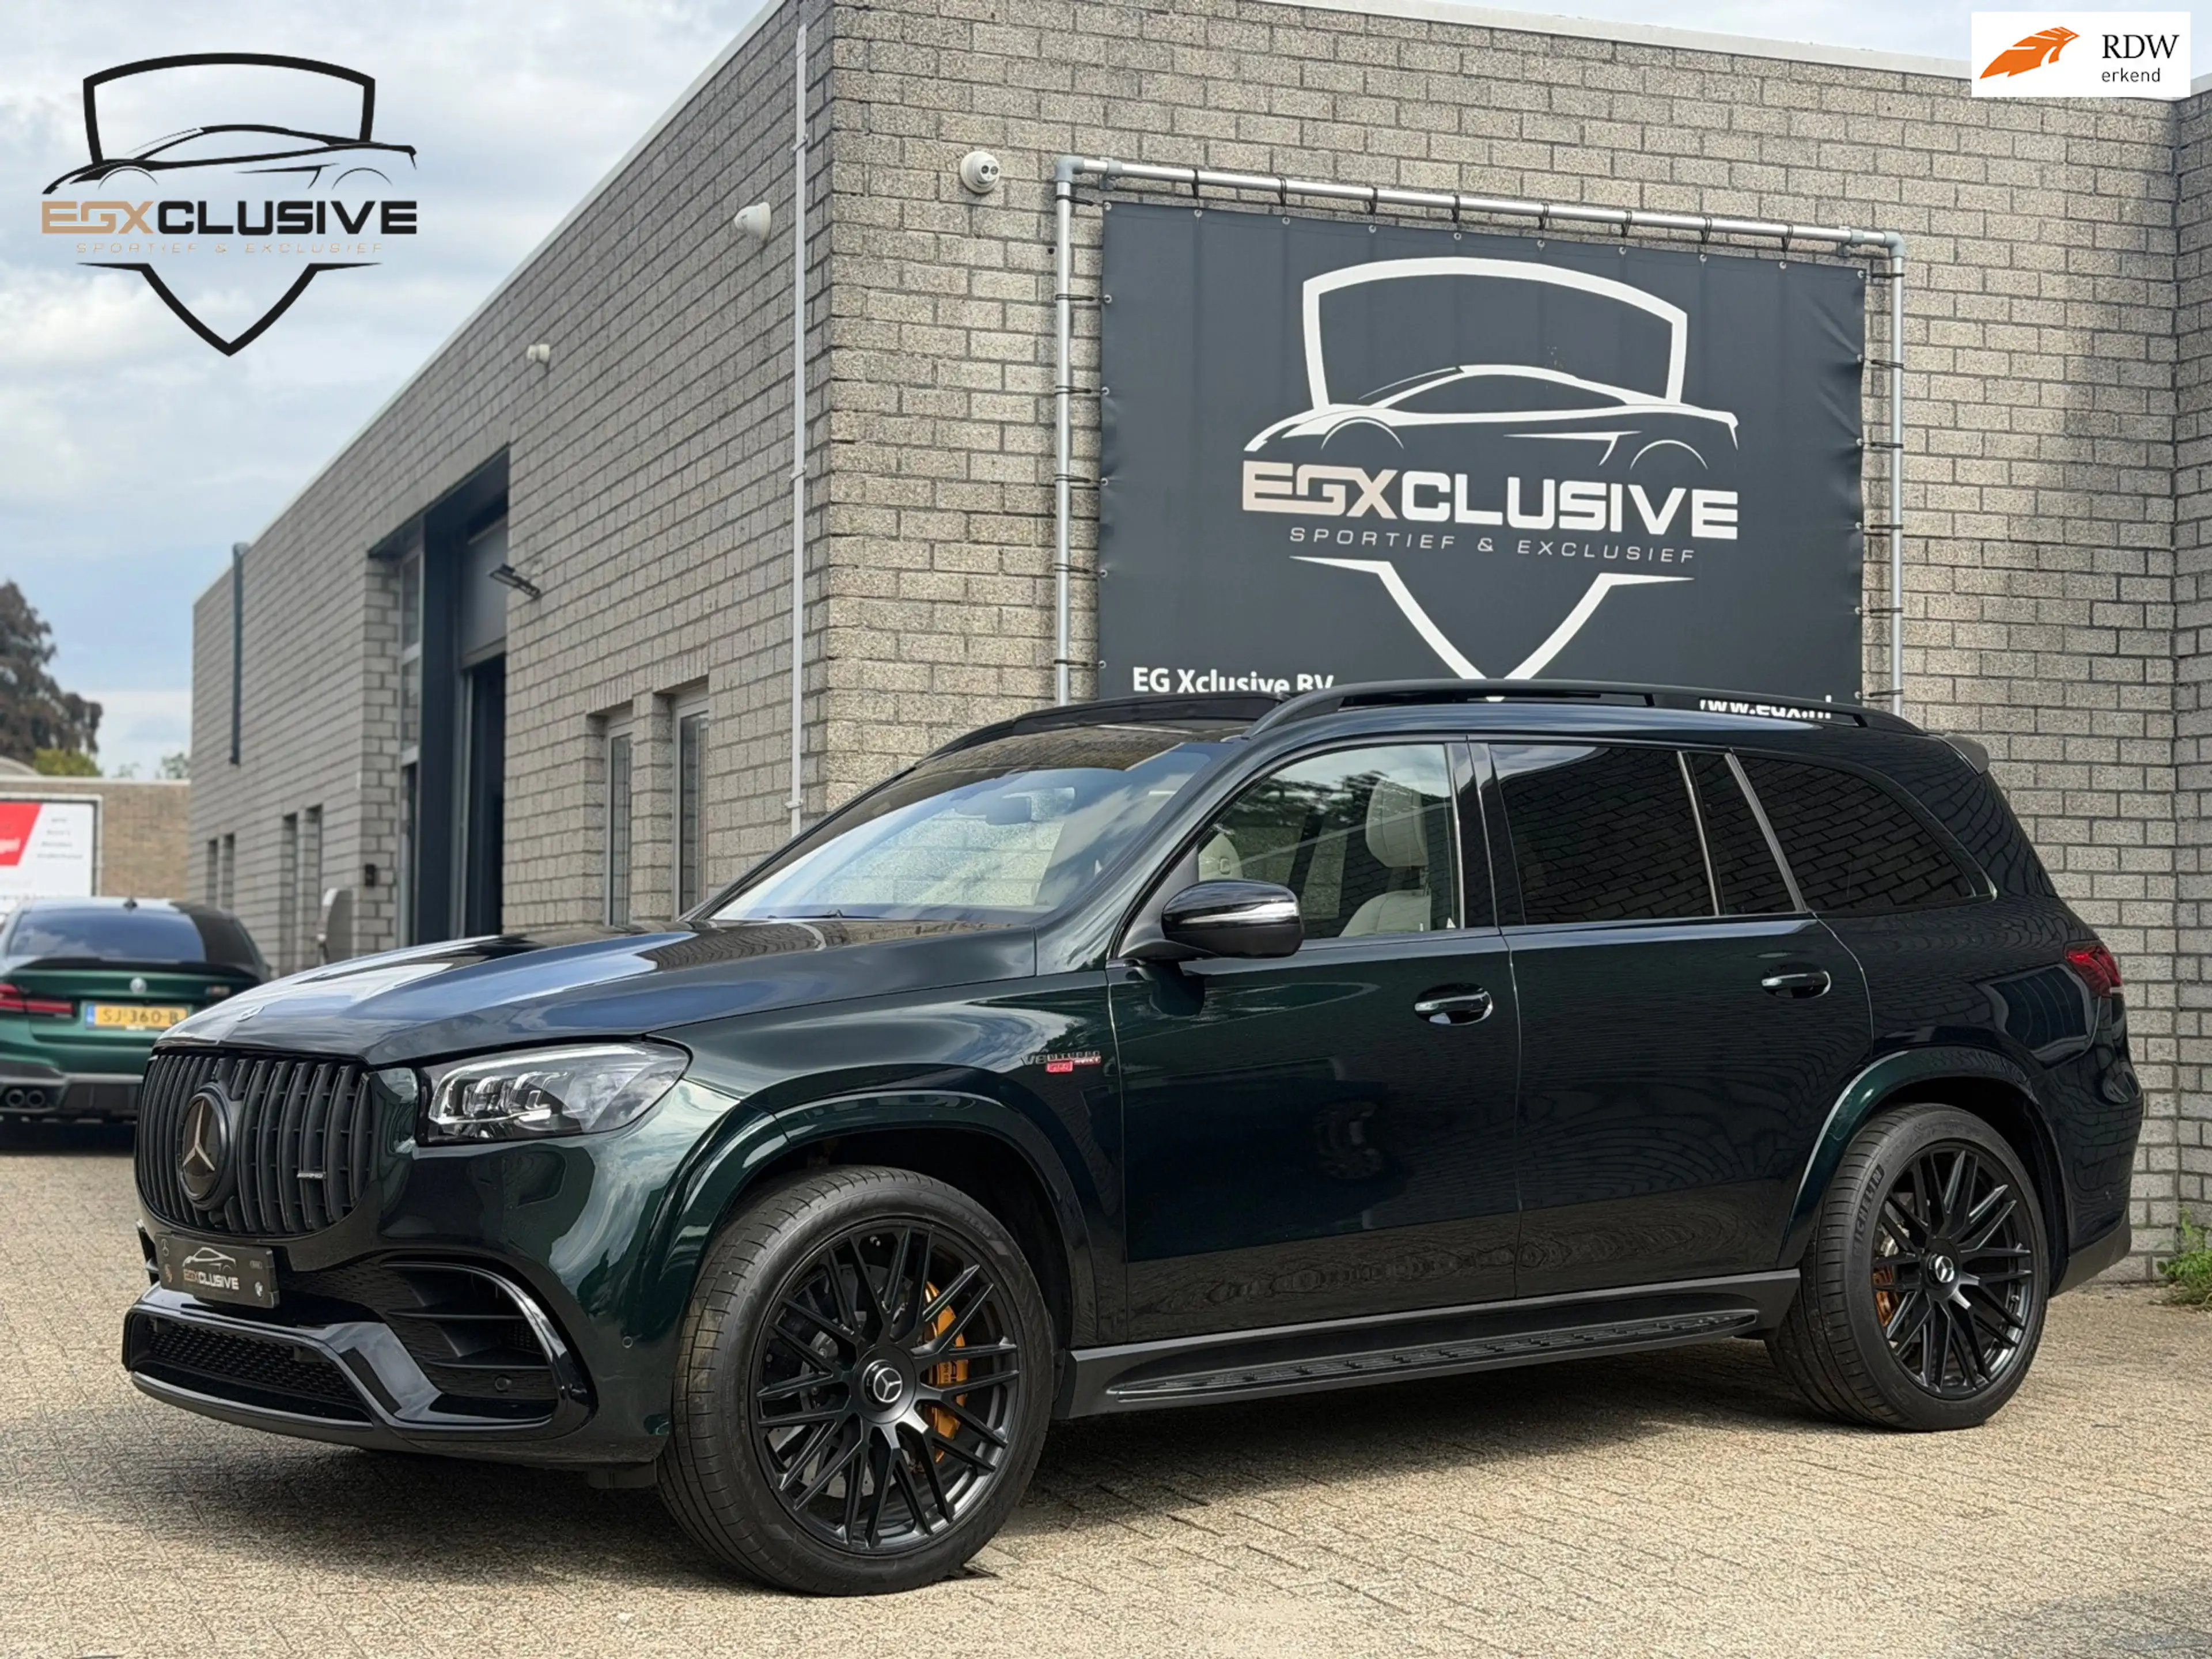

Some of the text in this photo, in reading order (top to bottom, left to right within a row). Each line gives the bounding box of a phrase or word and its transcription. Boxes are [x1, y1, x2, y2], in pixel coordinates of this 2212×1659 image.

[1243, 460, 1738, 540] EGXCLUSIVE
[1289, 527, 1696, 564] SPORTIEF & EXCLUSIEF
[1133, 667, 1170, 692] EG
[1177, 669, 1290, 694] Xclusive
